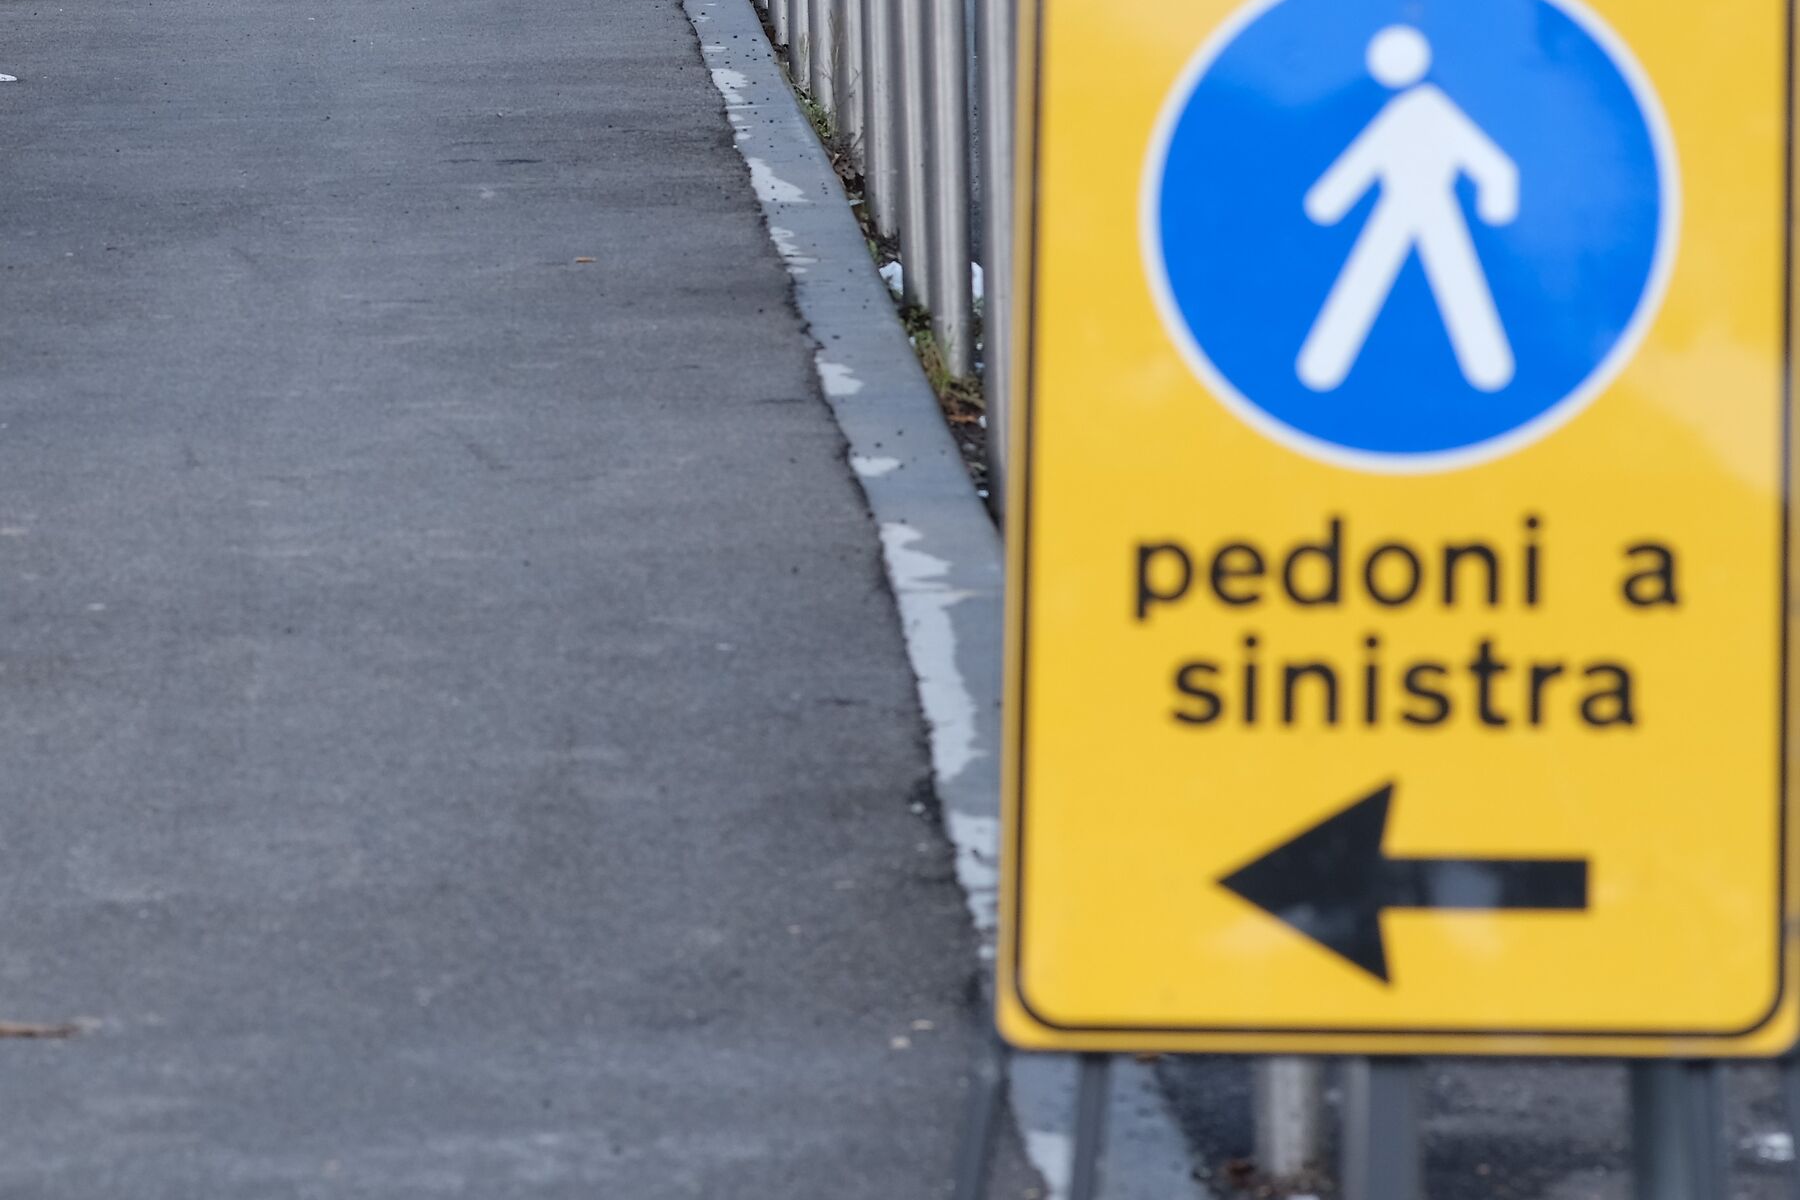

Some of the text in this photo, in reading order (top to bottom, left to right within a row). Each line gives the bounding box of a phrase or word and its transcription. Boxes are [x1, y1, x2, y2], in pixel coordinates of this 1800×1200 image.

[1134, 513, 1679, 622] pedoni a
[1173, 634, 1638, 727] sinistra
